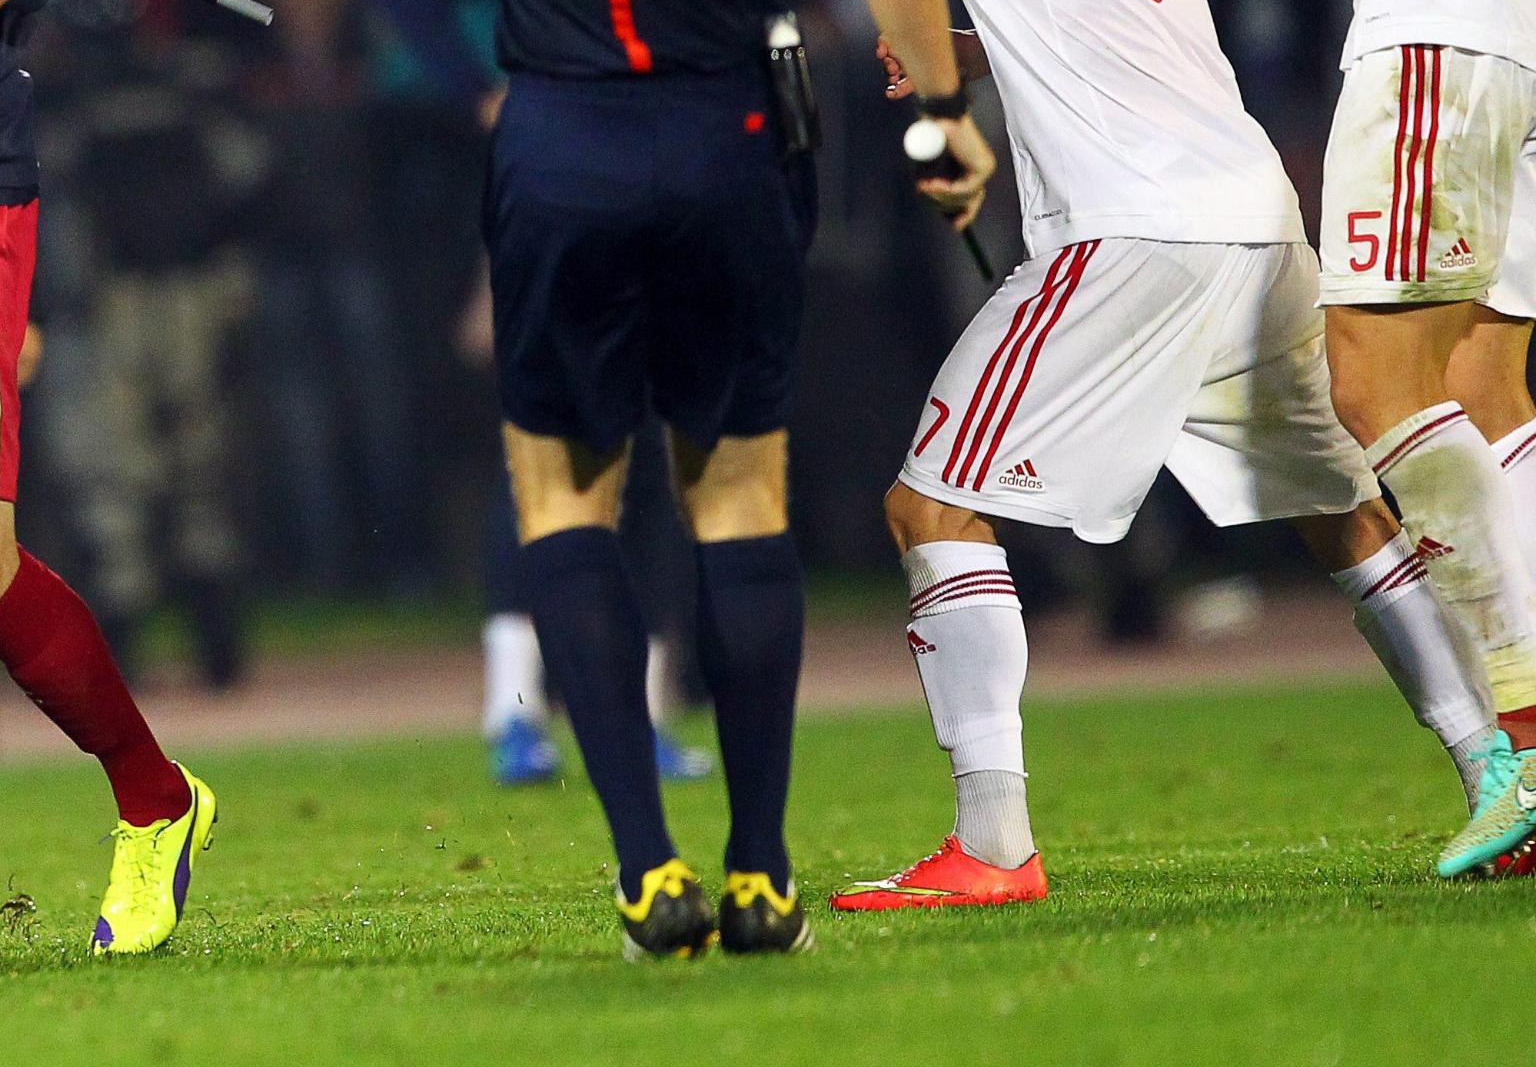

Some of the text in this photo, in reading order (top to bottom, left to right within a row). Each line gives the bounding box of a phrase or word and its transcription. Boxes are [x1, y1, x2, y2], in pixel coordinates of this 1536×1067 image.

[1347, 210, 1383, 273] 5
[1440, 254, 1476, 269] adidas
[913, 396, 951, 458] 7
[998, 474, 1044, 490] adidas
